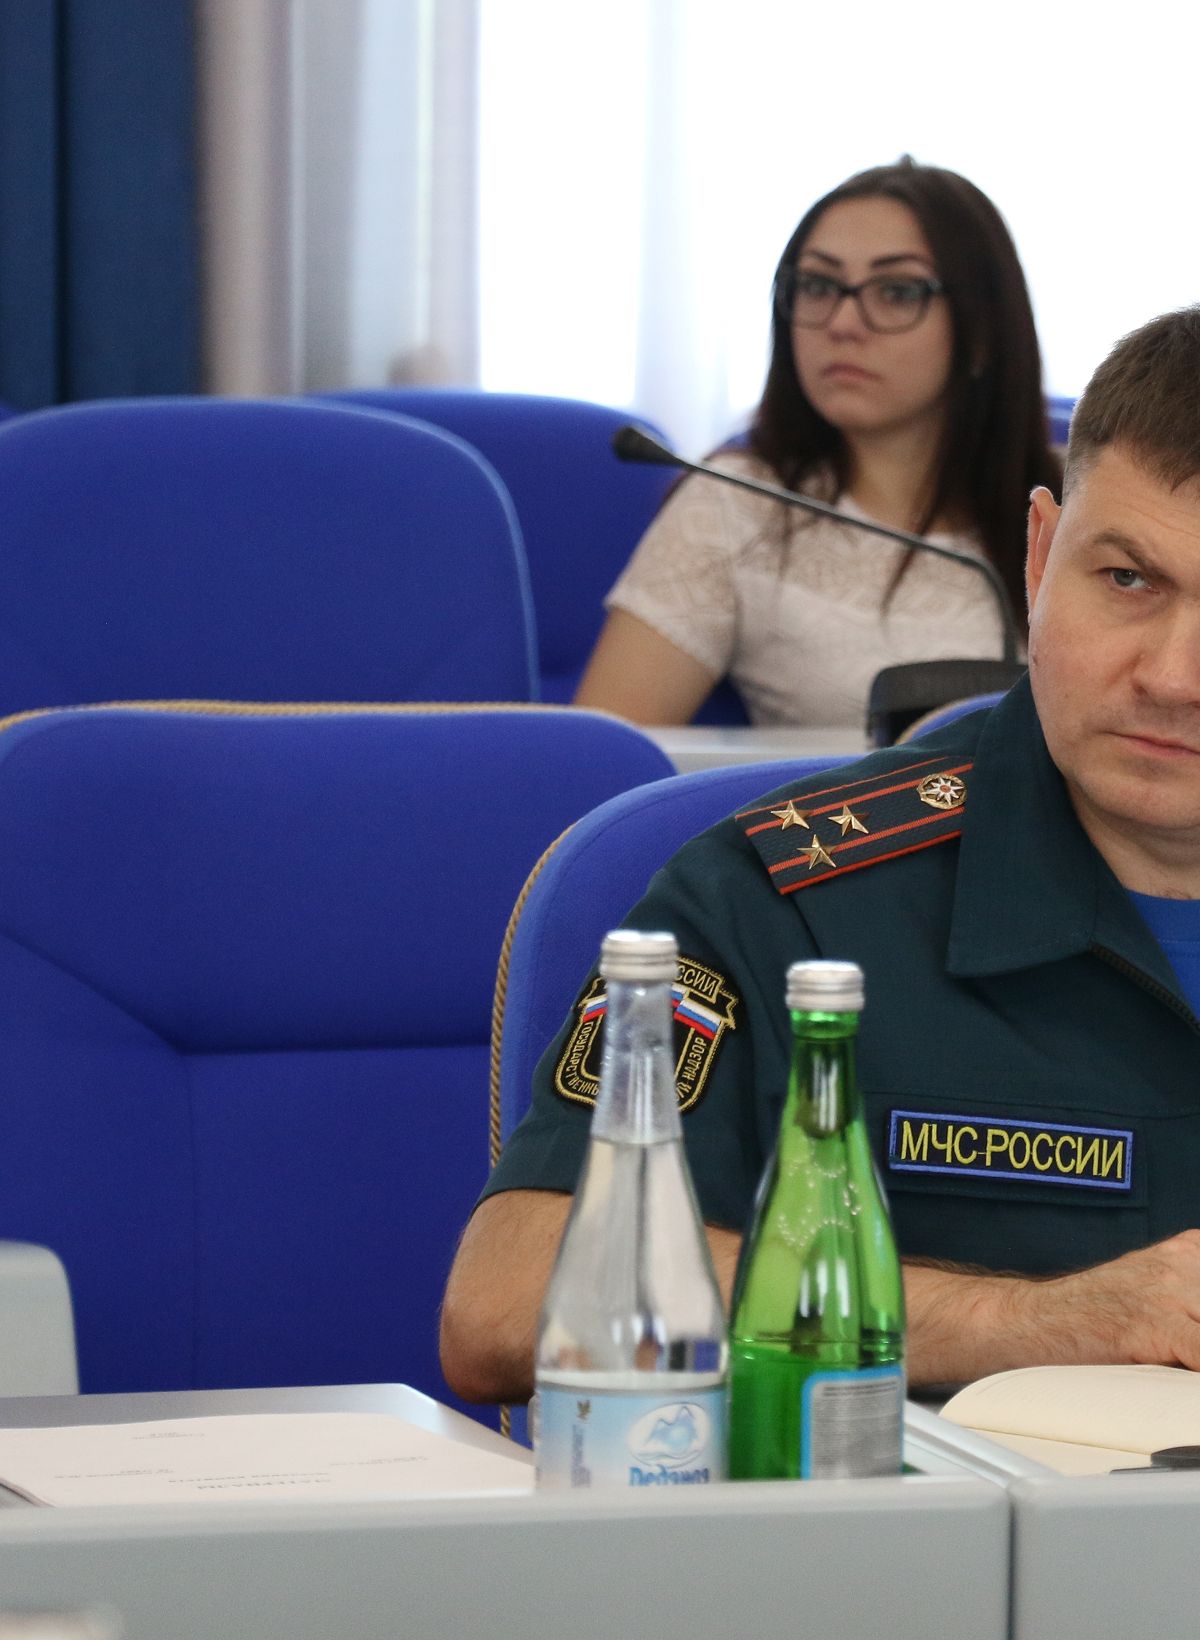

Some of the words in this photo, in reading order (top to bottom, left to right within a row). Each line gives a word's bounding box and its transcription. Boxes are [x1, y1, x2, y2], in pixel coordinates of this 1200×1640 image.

[675, 964, 717, 996] ССИИ
[565, 1021, 600, 1096] ГОСУДАРСТВЕННЫ
[682, 1037, 707, 1081] НАДЗОР
